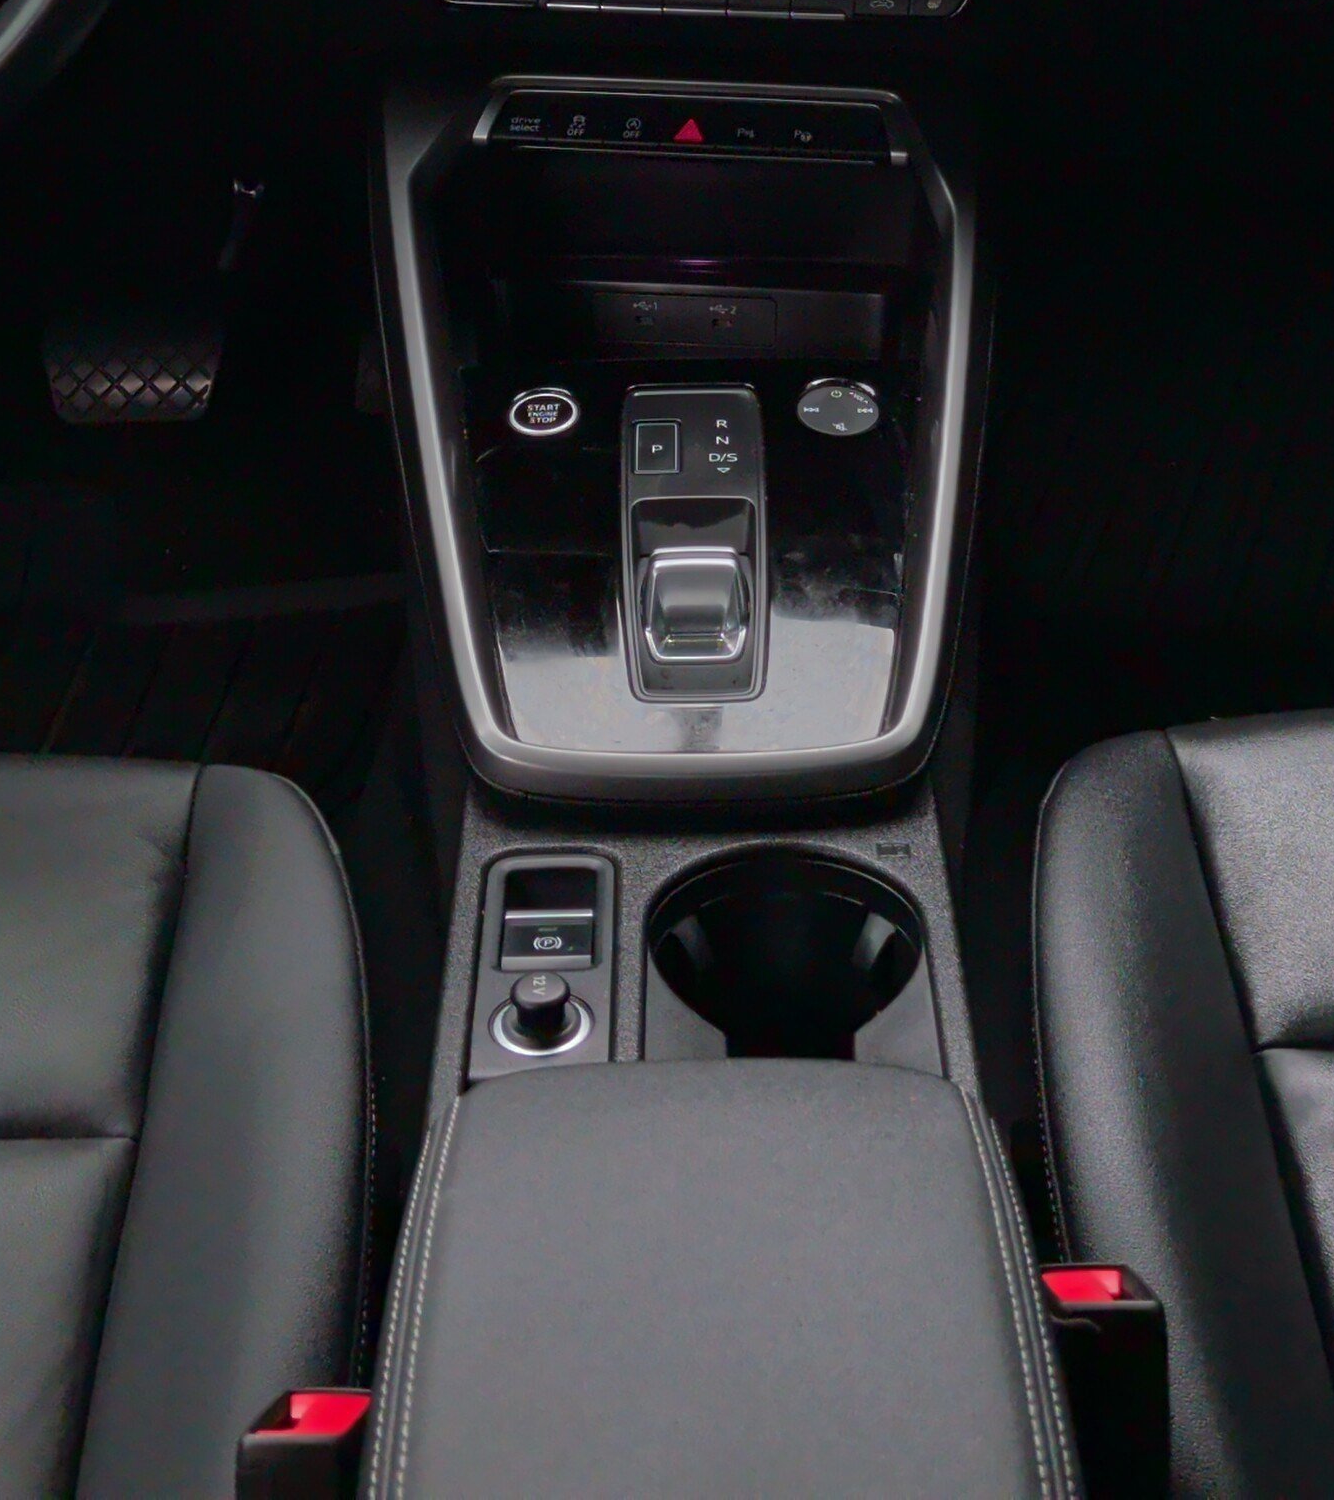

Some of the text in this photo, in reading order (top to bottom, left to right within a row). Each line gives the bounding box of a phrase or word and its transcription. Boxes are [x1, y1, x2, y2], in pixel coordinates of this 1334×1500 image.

[510, 116, 542, 124] drive
[509, 123, 541, 132] select
[566, 128, 586, 137] OFF
[622, 130, 642, 139] OFF
[527, 403, 560, 411] START
[715, 419, 728, 429] R
[715, 436, 730, 445] N
[651, 444, 663, 454] P
[708, 453, 738, 463] D/S
